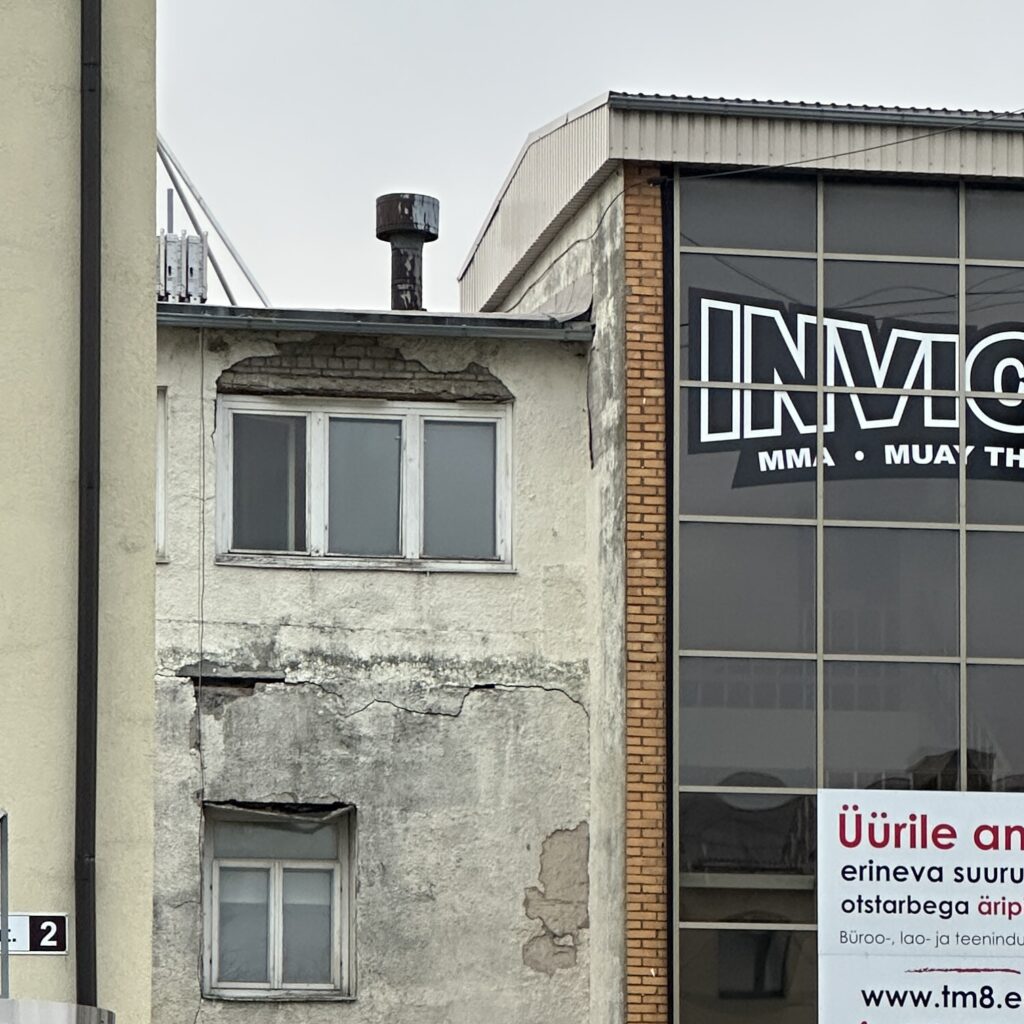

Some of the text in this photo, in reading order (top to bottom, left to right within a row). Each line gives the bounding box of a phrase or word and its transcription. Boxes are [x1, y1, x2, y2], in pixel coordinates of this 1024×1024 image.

[758, 447, 836, 472] MMA
[884, 444, 975, 465] MUAY
[838, 804, 957, 850] Üürile
[841, 859, 943, 883] erineva
[841, 894, 969, 919] otstarbega
[40, 921, 57, 947] 2
[839, 930, 895, 946] Büroo-,
[900, 931, 932, 945] lao-
[934, 931, 950, 948] ja
